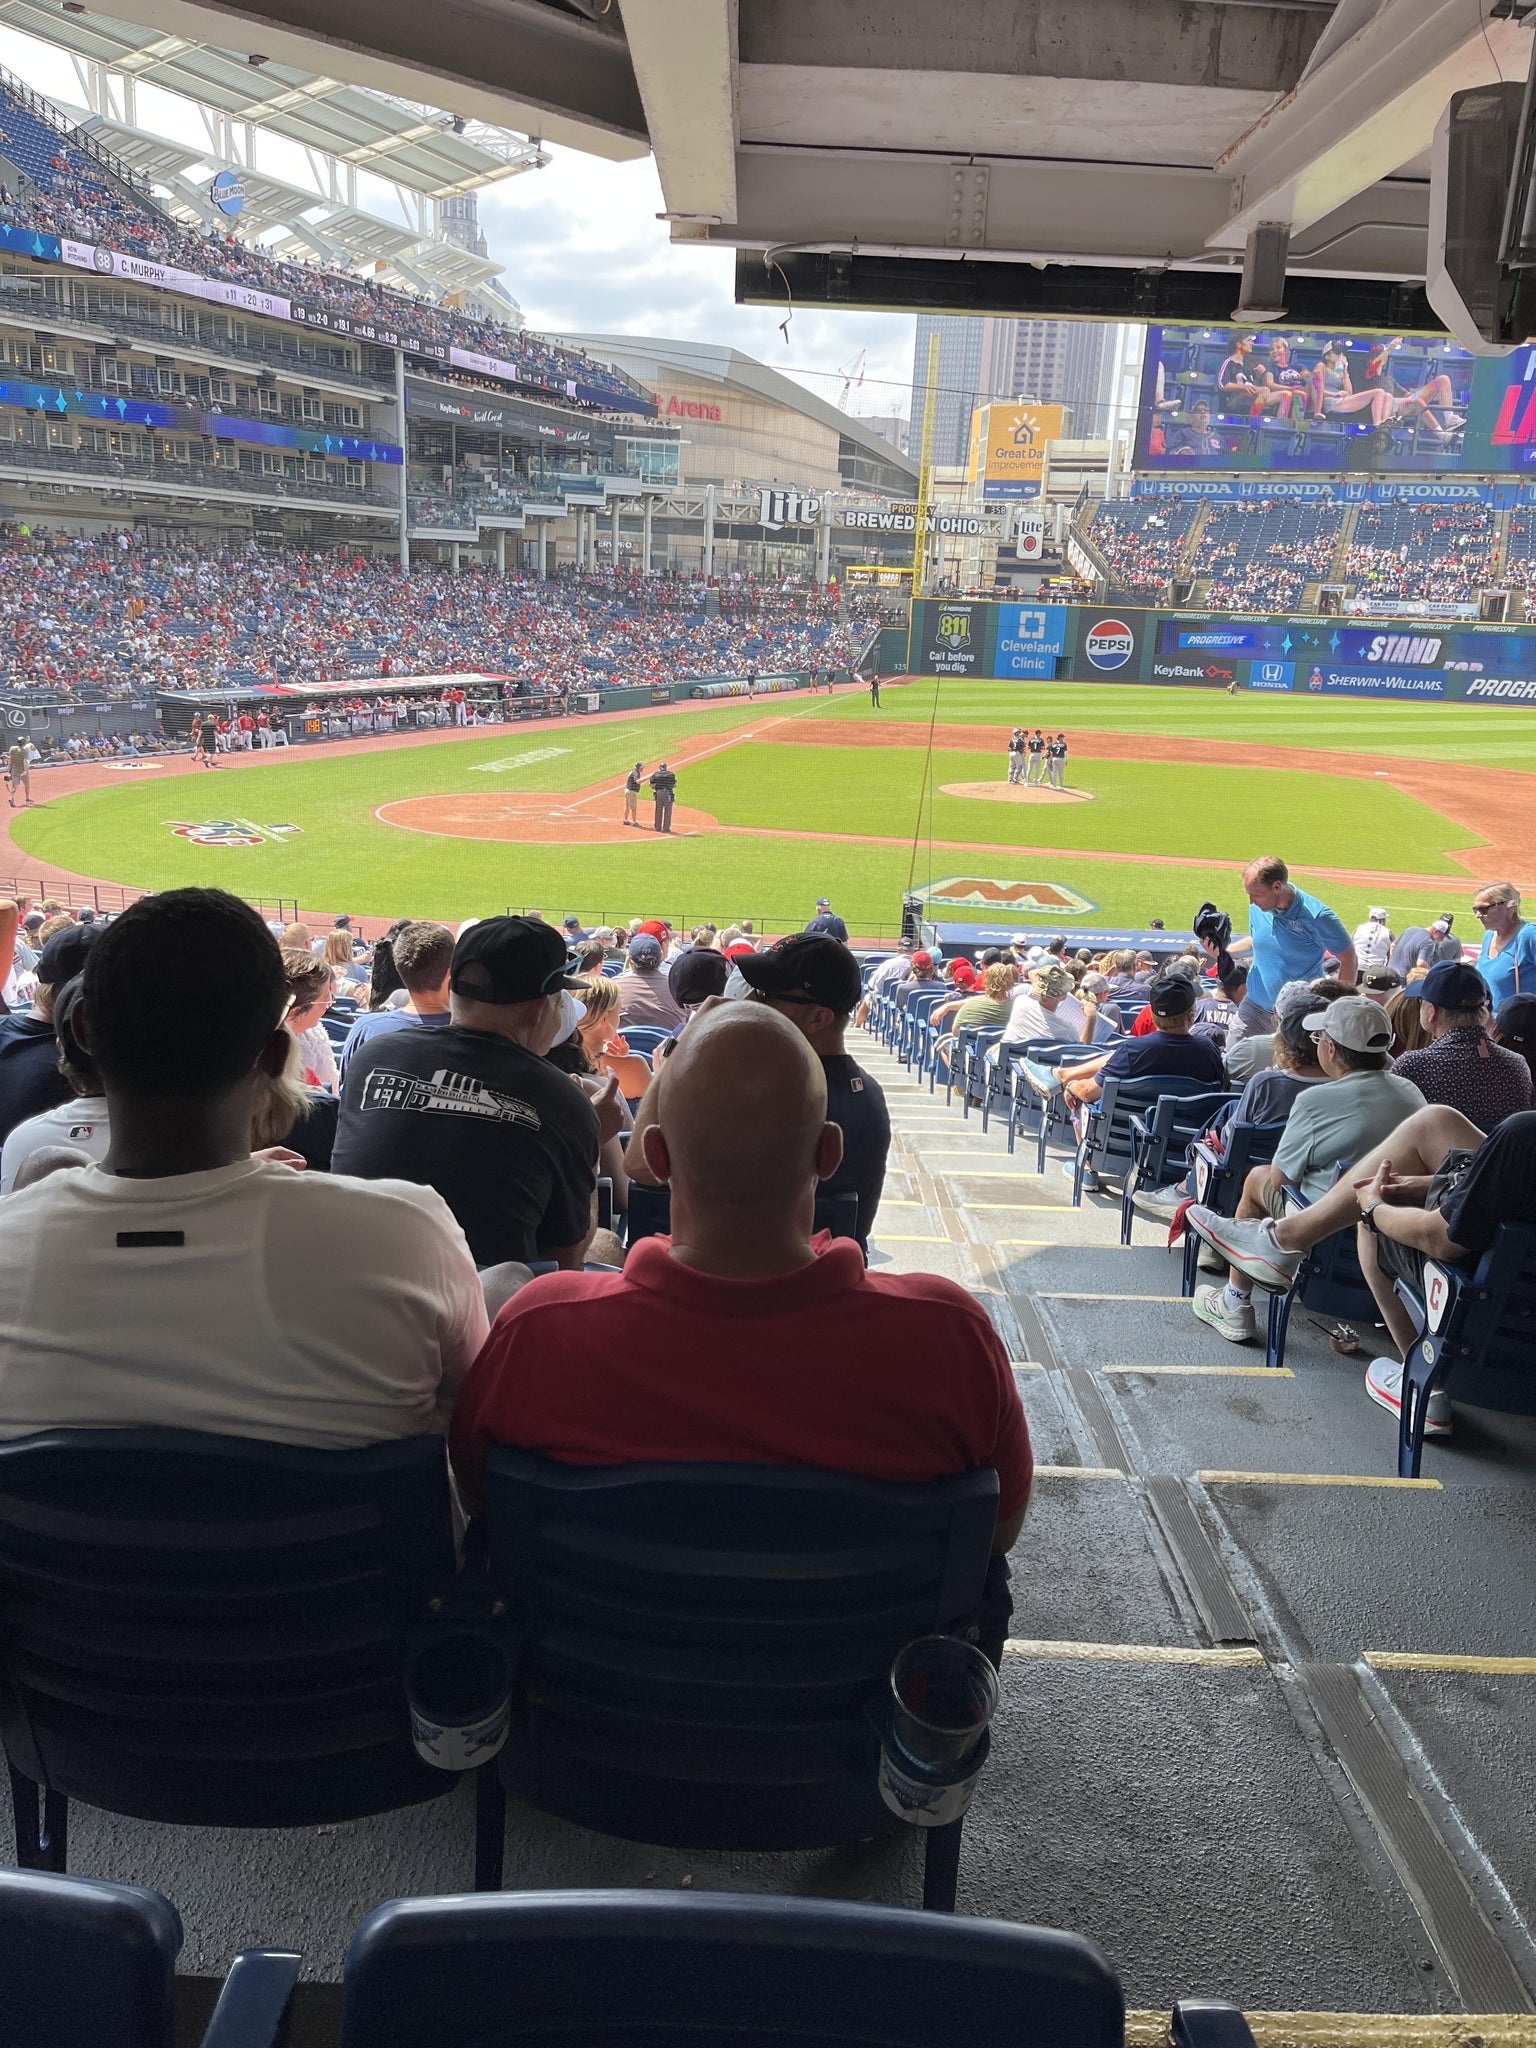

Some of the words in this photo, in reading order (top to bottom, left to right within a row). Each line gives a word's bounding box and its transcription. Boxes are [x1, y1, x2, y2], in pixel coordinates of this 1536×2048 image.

[213, 187, 229, 201] BLUE
[229, 185, 245, 197] MOON
[97, 253, 111, 268] 38
[130, 262, 165, 281] MURPHY
[439, 403, 461, 416] KeyBank
[666, 395, 722, 421] Arena
[538, 425, 556, 436] KeyBank
[995, 447, 1025, 459] Great
[1159, 483, 1232, 495] HONDA
[1256, 484, 1335, 497] HONDA
[1399, 486, 1481, 498] HONDA
[756, 489, 820, 531] Lite
[845, 512, 915, 530] BREWED
[940, 517, 980, 534] OHIO
[1020, 520, 1043, 533] Lite
[1229, 615, 1271, 623] PROGRESSIVE
[1287, 617, 1331, 625] PROGRESSIVE
[1347, 619, 1392, 628] PROGRESSIVE
[940, 615, 967, 637] 811
[1408, 622, 1455, 631] PROGRESSIVE
[1472, 625, 1520, 633] PROGRESSIVE
[1089, 639, 1131, 651] PEPSI
[1187, 635, 1247, 645] PROGRESSIVE
[1001, 640, 1060, 654] Cleveland
[1367, 635, 1442, 664] STAND
[929, 651, 945, 662] Call
[948, 652, 975, 663] before
[1011, 656, 1045, 670] Clinic
[893, 663, 907, 671] 325
[935, 663, 951, 673] you
[951, 662, 967, 674] dig.
[1154, 664, 1204, 678] KeyBank
[1252, 681, 1288, 689] HONDA
[1429, 1278, 1442, 1310] C
